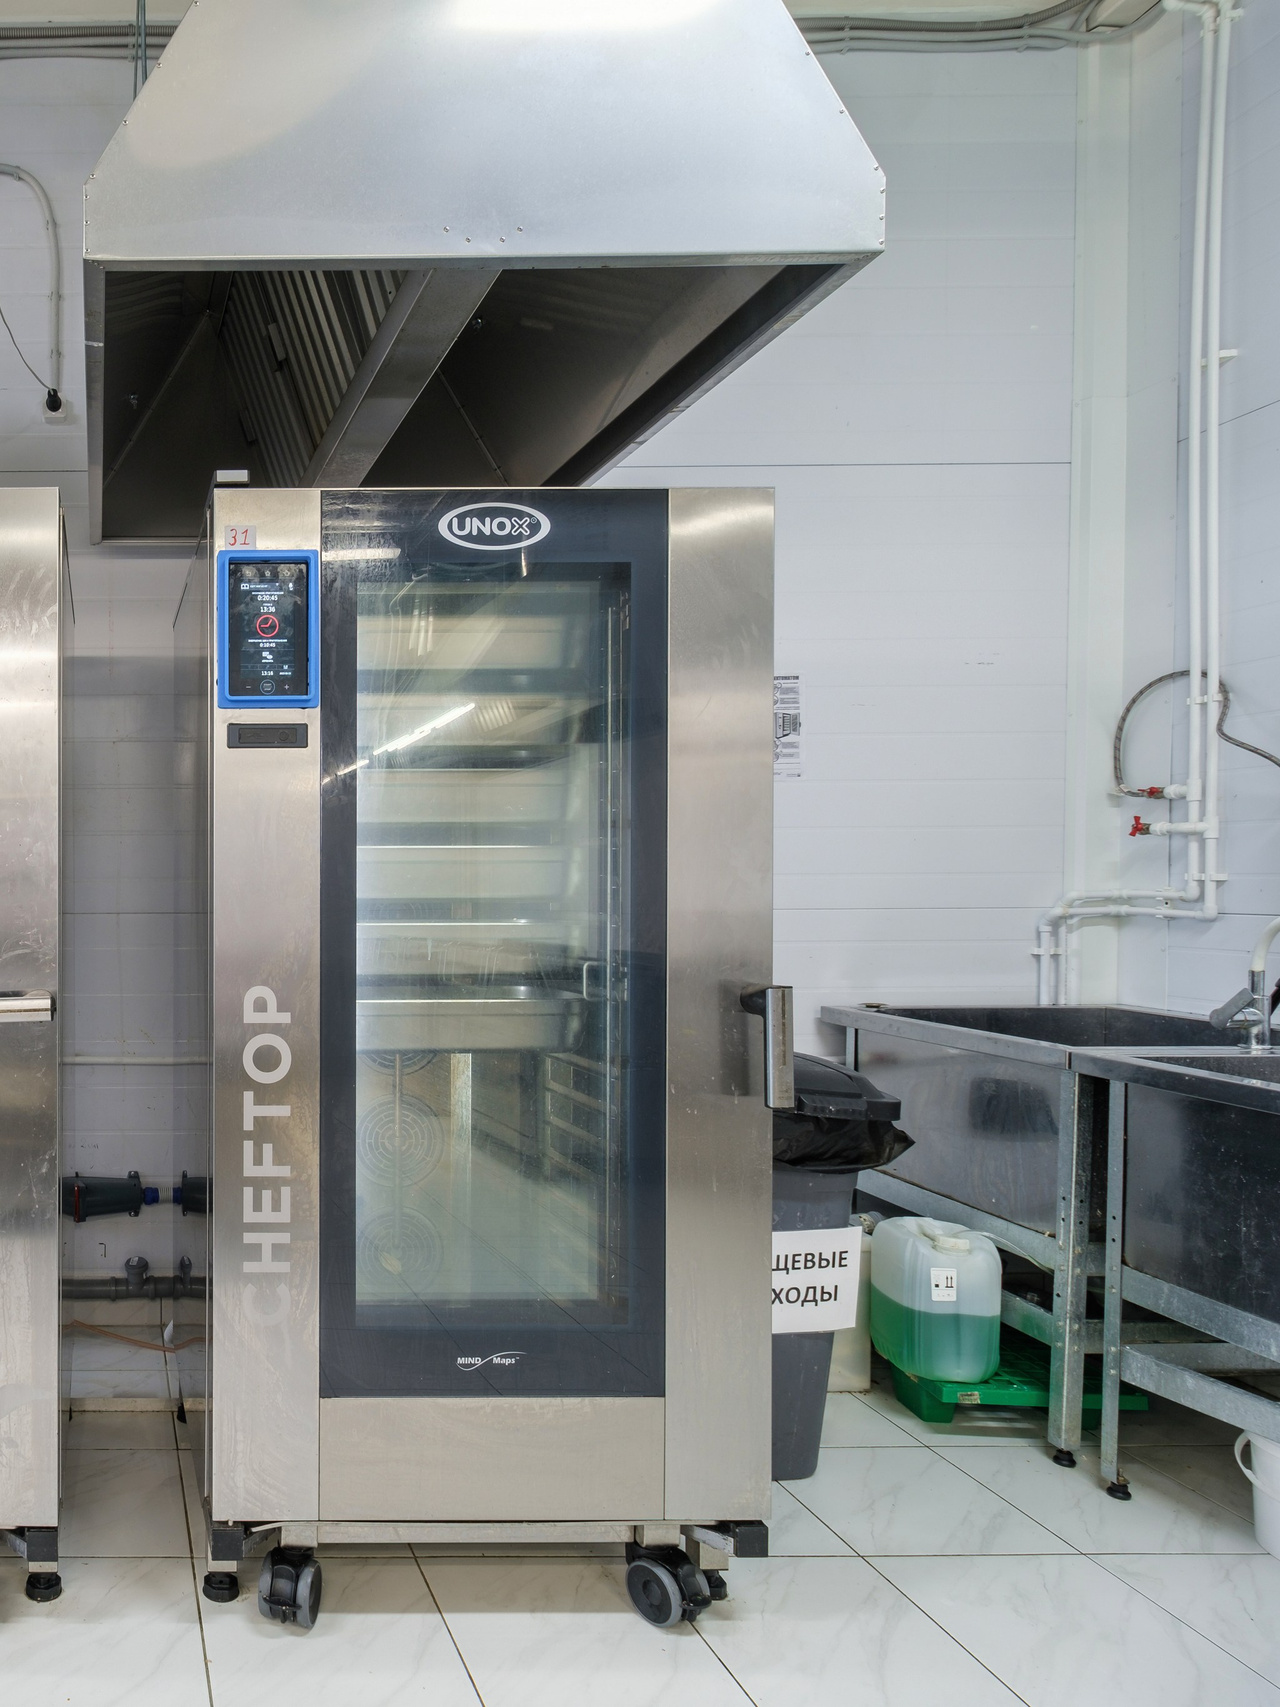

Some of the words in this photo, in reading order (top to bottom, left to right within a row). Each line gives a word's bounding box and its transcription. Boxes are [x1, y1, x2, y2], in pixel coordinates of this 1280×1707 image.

[452, 517, 530, 536] UNOX
[228, 528, 250, 546] 31
[242, 985, 292, 1327] CHEFTOP
[492, 1357, 516, 1366] Maps
